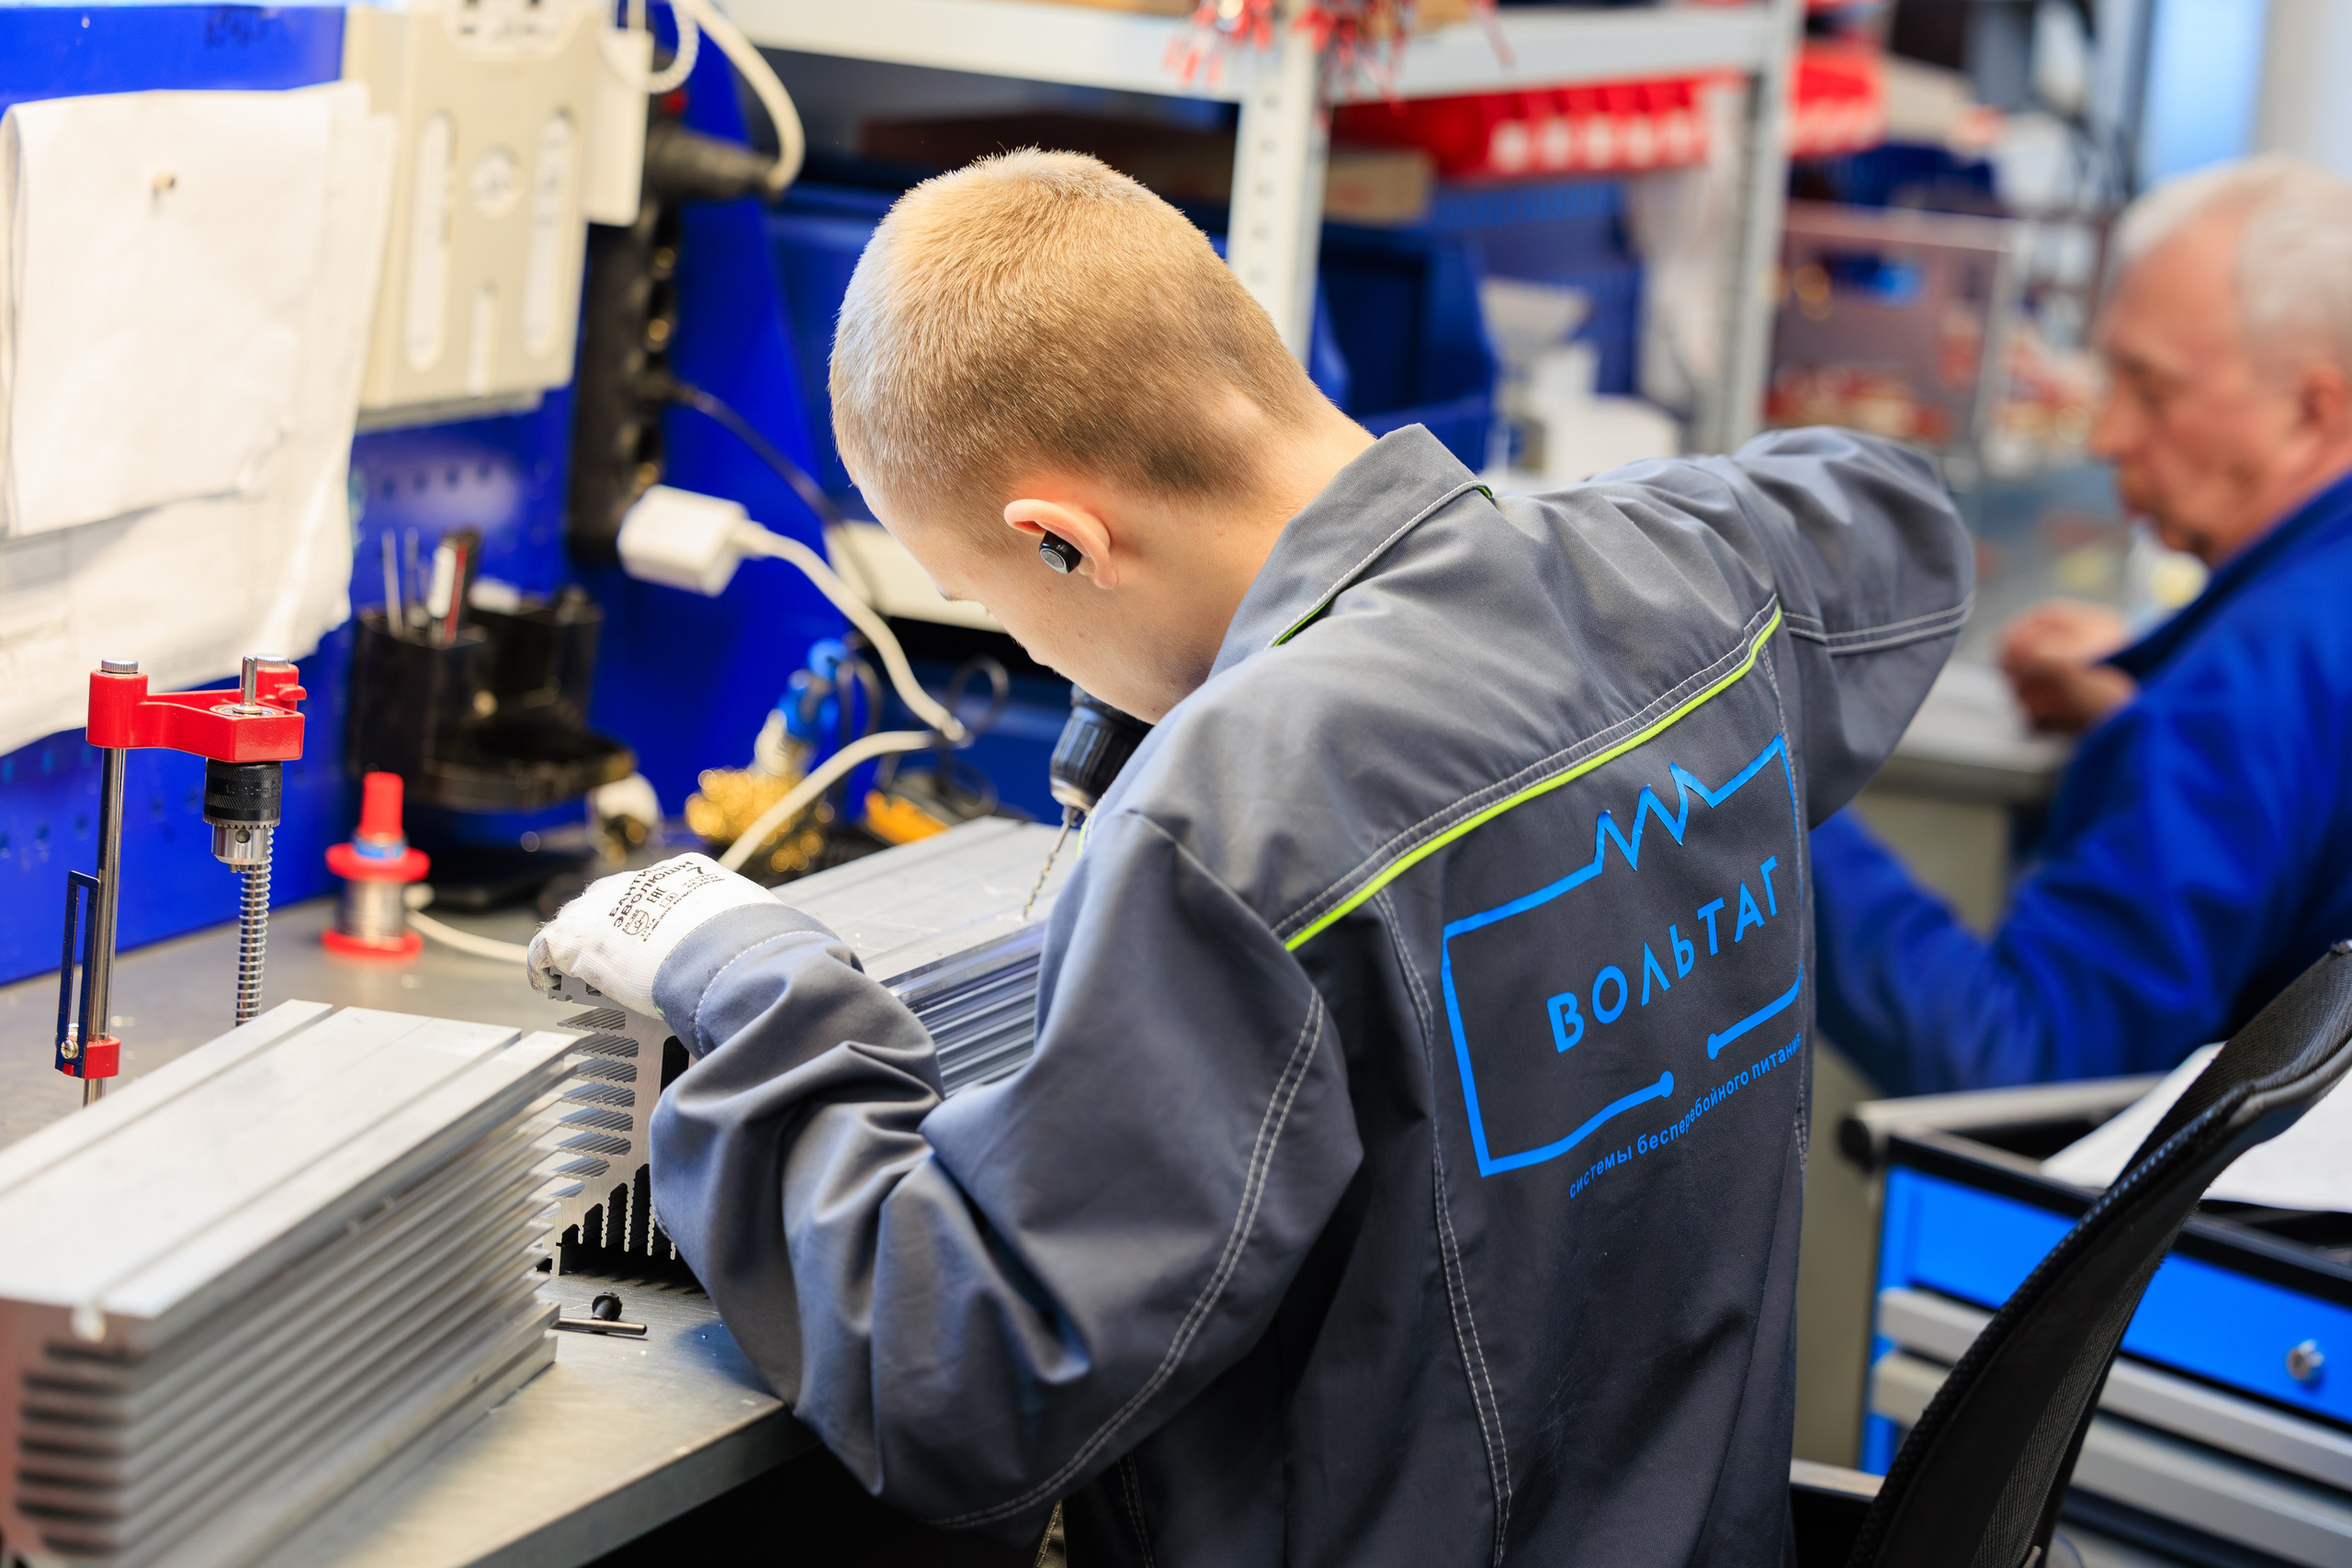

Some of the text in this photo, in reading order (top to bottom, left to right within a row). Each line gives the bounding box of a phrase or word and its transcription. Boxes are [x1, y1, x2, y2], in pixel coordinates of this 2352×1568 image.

[614, 861, 694, 928] ЭВОЛЮШН
[1546, 855, 1778, 1054] ВОЛЬТАГ
[1569, 1145, 1633, 1199] системы
[1637, 1070, 1749, 1155] бесперебойного
